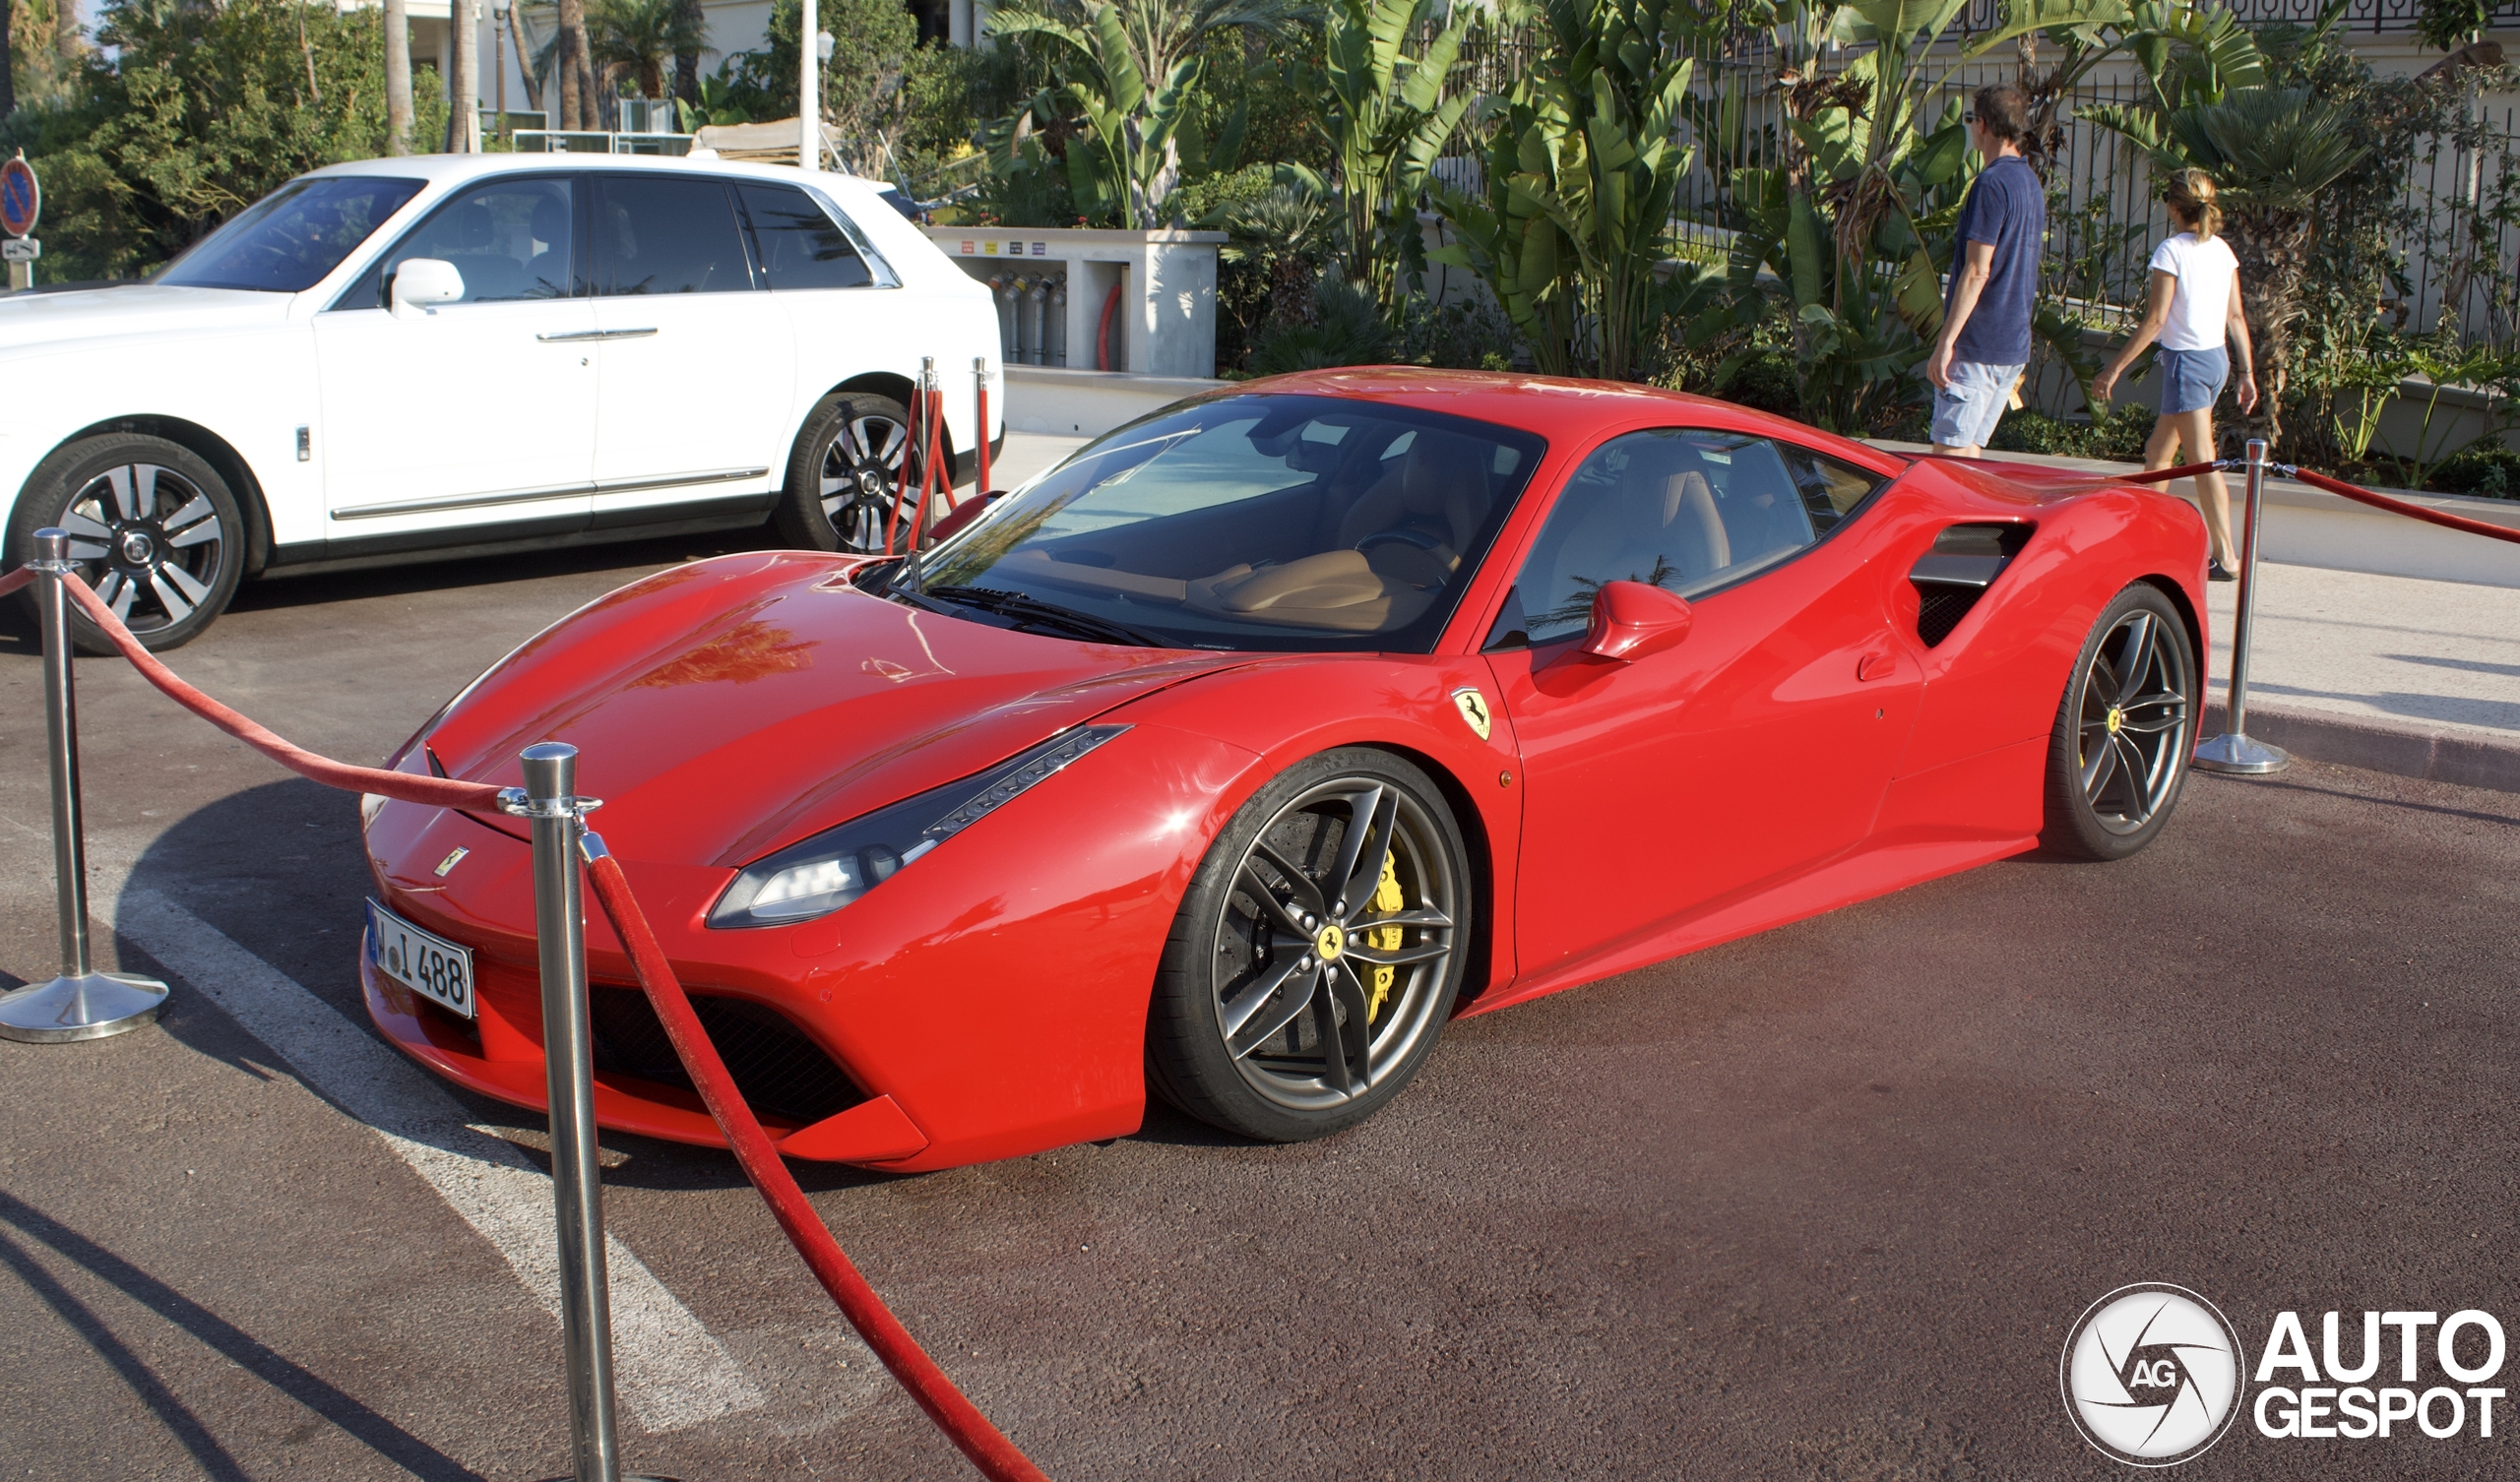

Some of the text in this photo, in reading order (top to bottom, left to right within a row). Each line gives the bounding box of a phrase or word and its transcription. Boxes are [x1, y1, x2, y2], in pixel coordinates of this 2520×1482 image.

[374, 914, 465, 1006] W I 488
